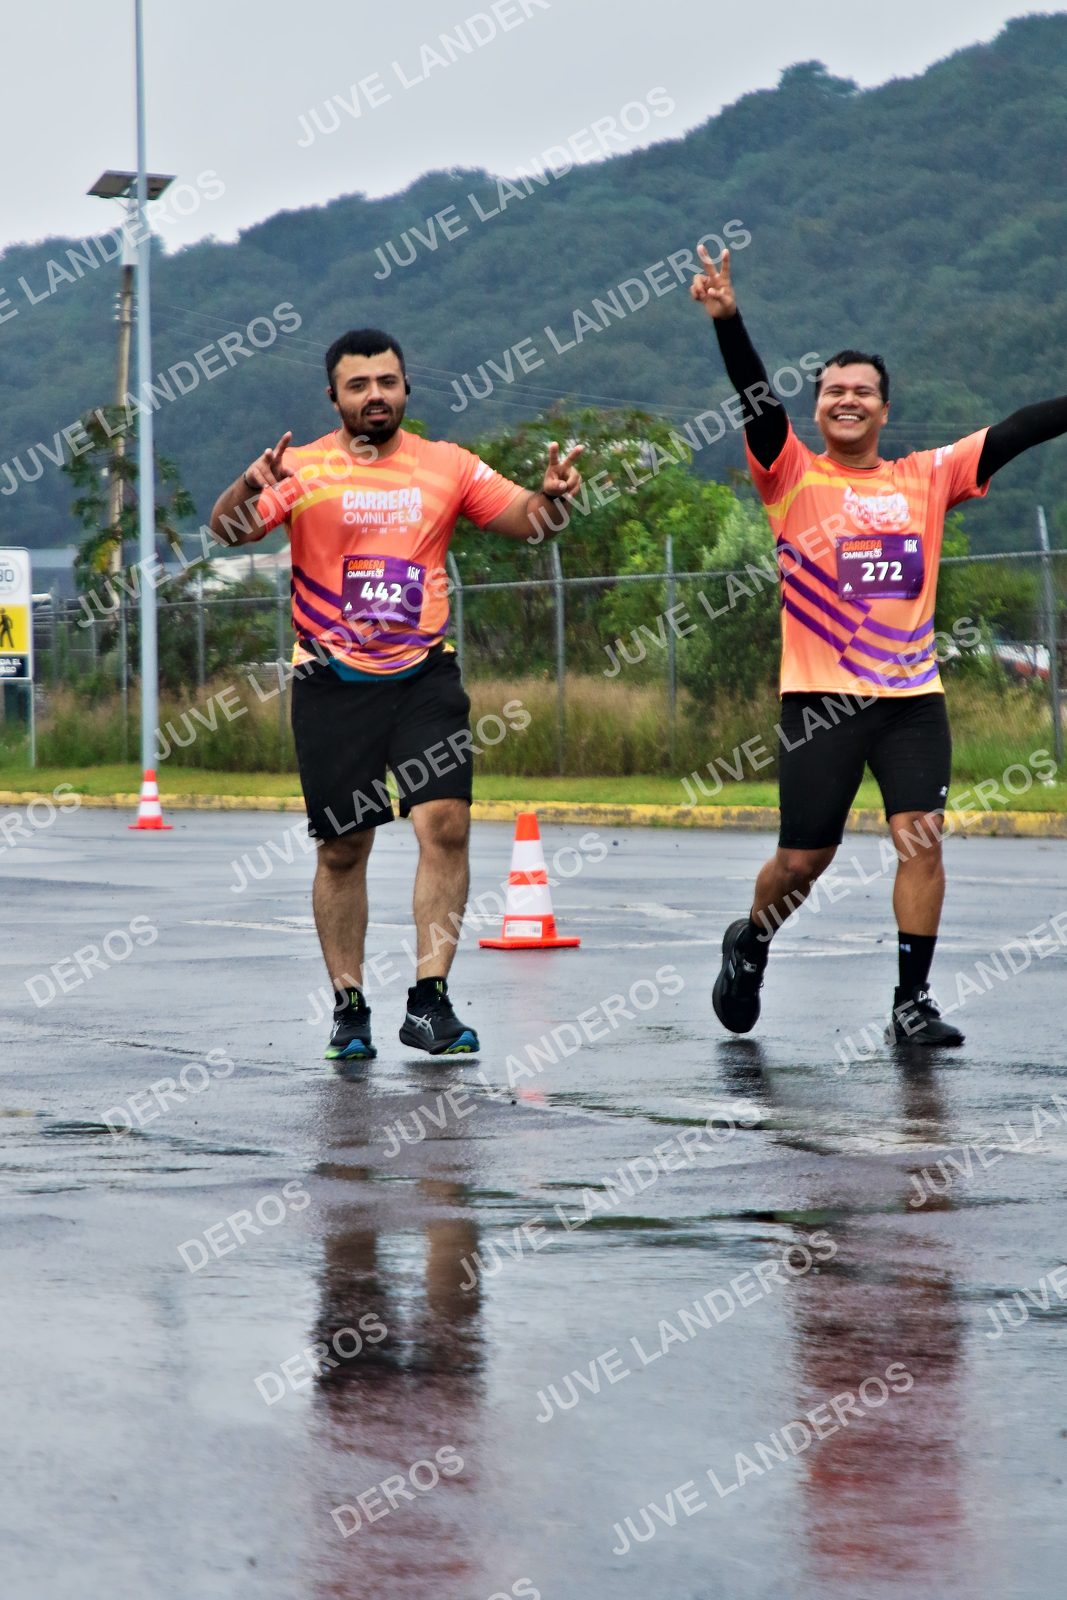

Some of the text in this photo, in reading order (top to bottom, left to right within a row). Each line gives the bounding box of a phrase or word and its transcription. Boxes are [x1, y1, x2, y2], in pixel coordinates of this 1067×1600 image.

[343, 487, 422, 509] CARRERA
[344, 511, 405, 524] OMNILIFE
[842, 539, 882, 551] CARRERA
[842, 550, 873, 559] OMNILIFE
[348, 559, 385, 570] CARRERA
[347, 570, 375, 578] OMNILIFE
[862, 561, 902, 582] 272
[360, 582, 402, 603] 442
